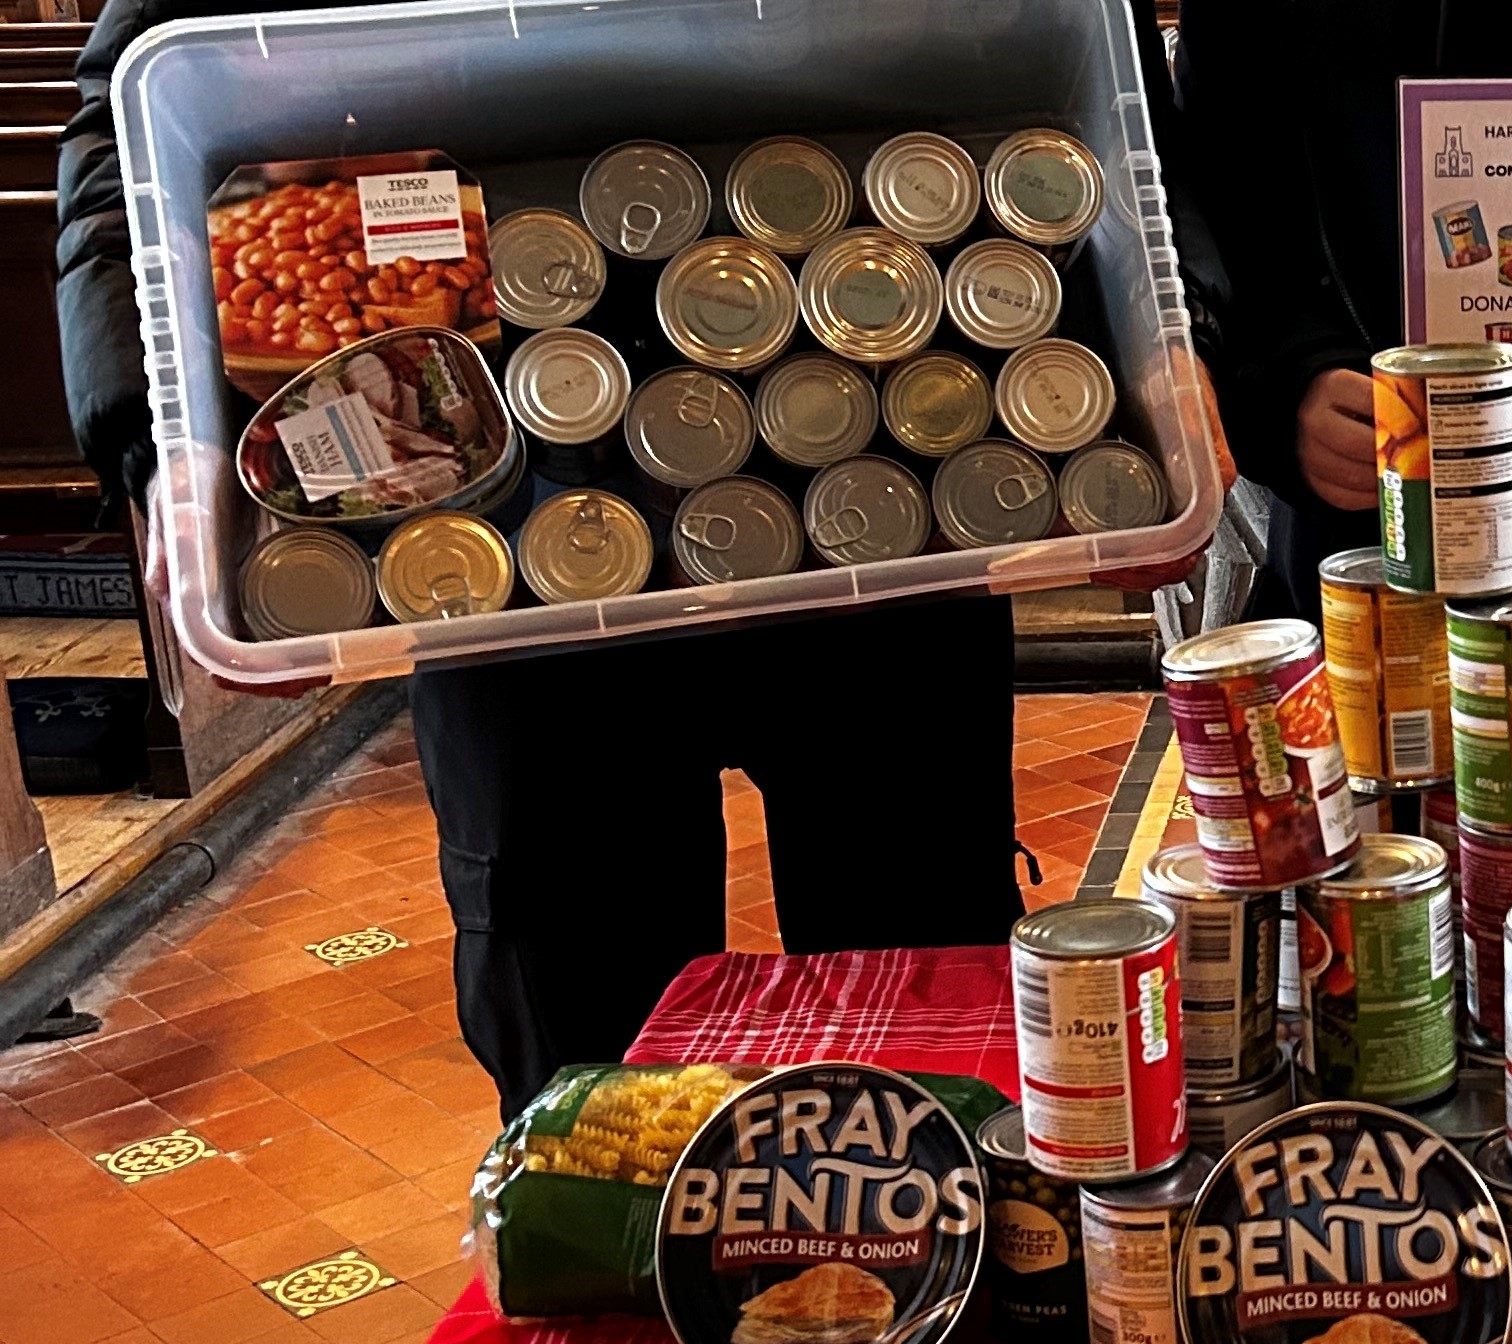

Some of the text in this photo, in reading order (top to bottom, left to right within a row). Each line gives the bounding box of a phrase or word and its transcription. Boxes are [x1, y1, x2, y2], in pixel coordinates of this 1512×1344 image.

[387, 178, 429, 190] TESCO
[364, 193, 456, 211] BAKED BEANS
[318, 431, 343, 467] HAM
[36, 575, 131, 606] JAMES
[1071, 1019, 1119, 1038] 410g
[734, 1088, 939, 1164] FRAY
[1236, 1129, 1444, 1217] FRAY
[669, 1158, 982, 1236] BENTOS
[722, 1238, 919, 1259] MINCED BEEF & ONION
[1189, 1204, 1506, 1297] BENTOS
[1247, 1284, 1447, 1317] MINCED BEEF & ONION
